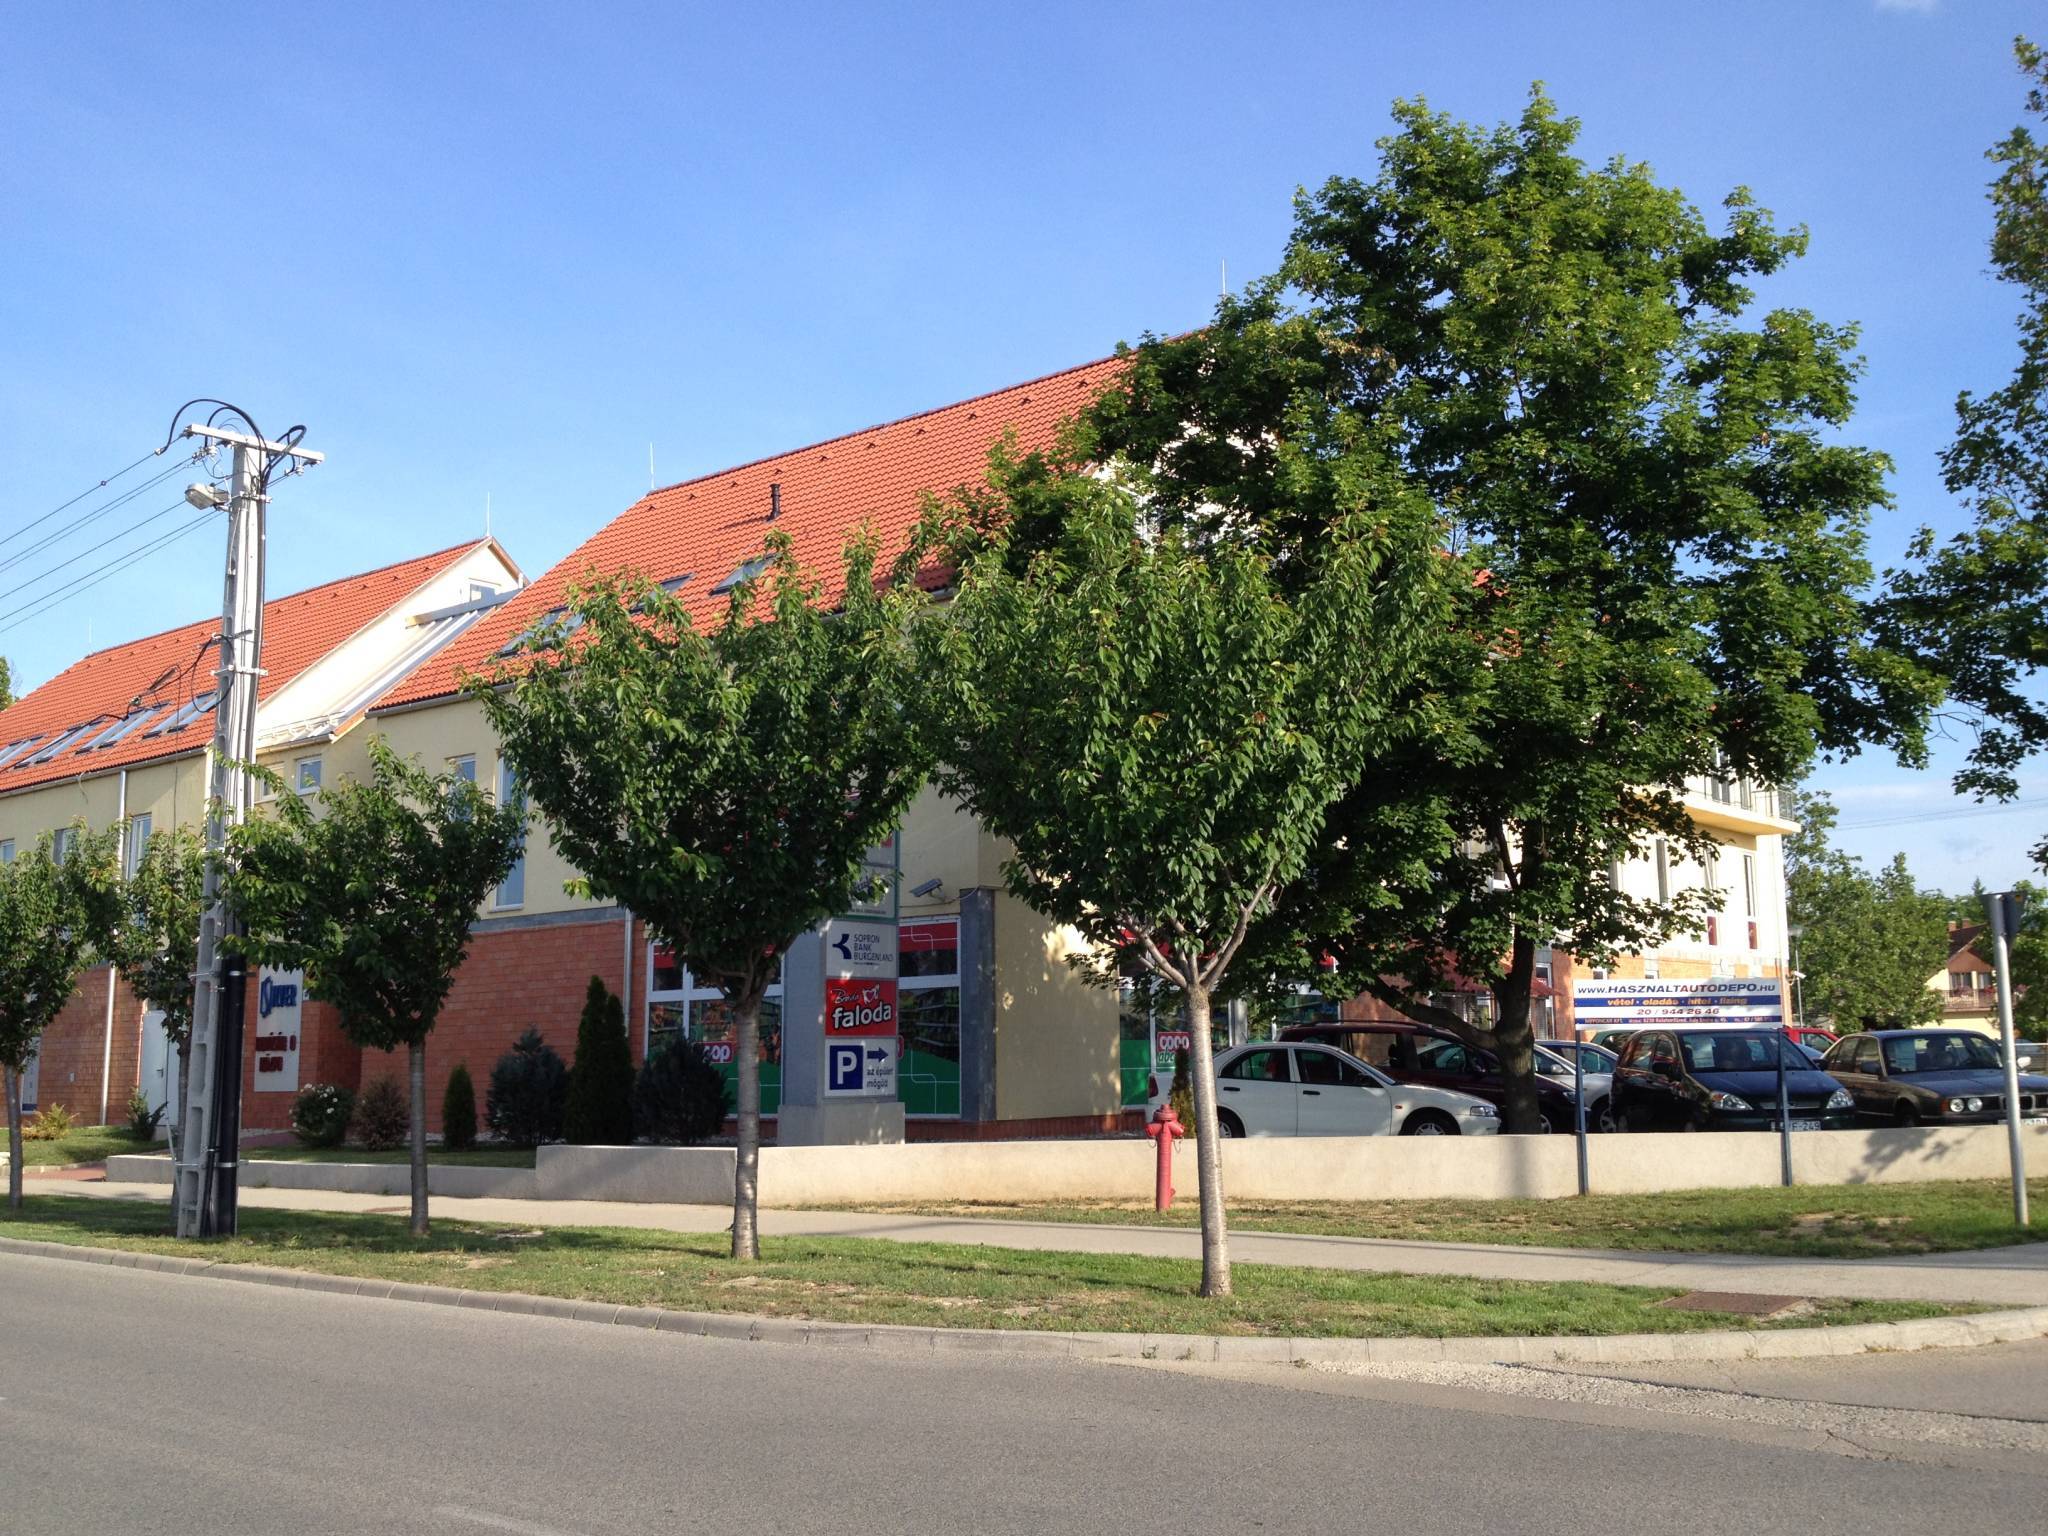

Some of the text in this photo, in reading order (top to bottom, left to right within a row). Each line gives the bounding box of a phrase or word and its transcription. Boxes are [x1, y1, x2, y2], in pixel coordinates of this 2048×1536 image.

[853, 933, 880, 944] SOPRON
[853, 942, 872, 953] BANK
[853, 952, 895, 962] BURGENLAND
[832, 1001, 893, 1029] faloda
[837, 1051, 858, 1085] P
